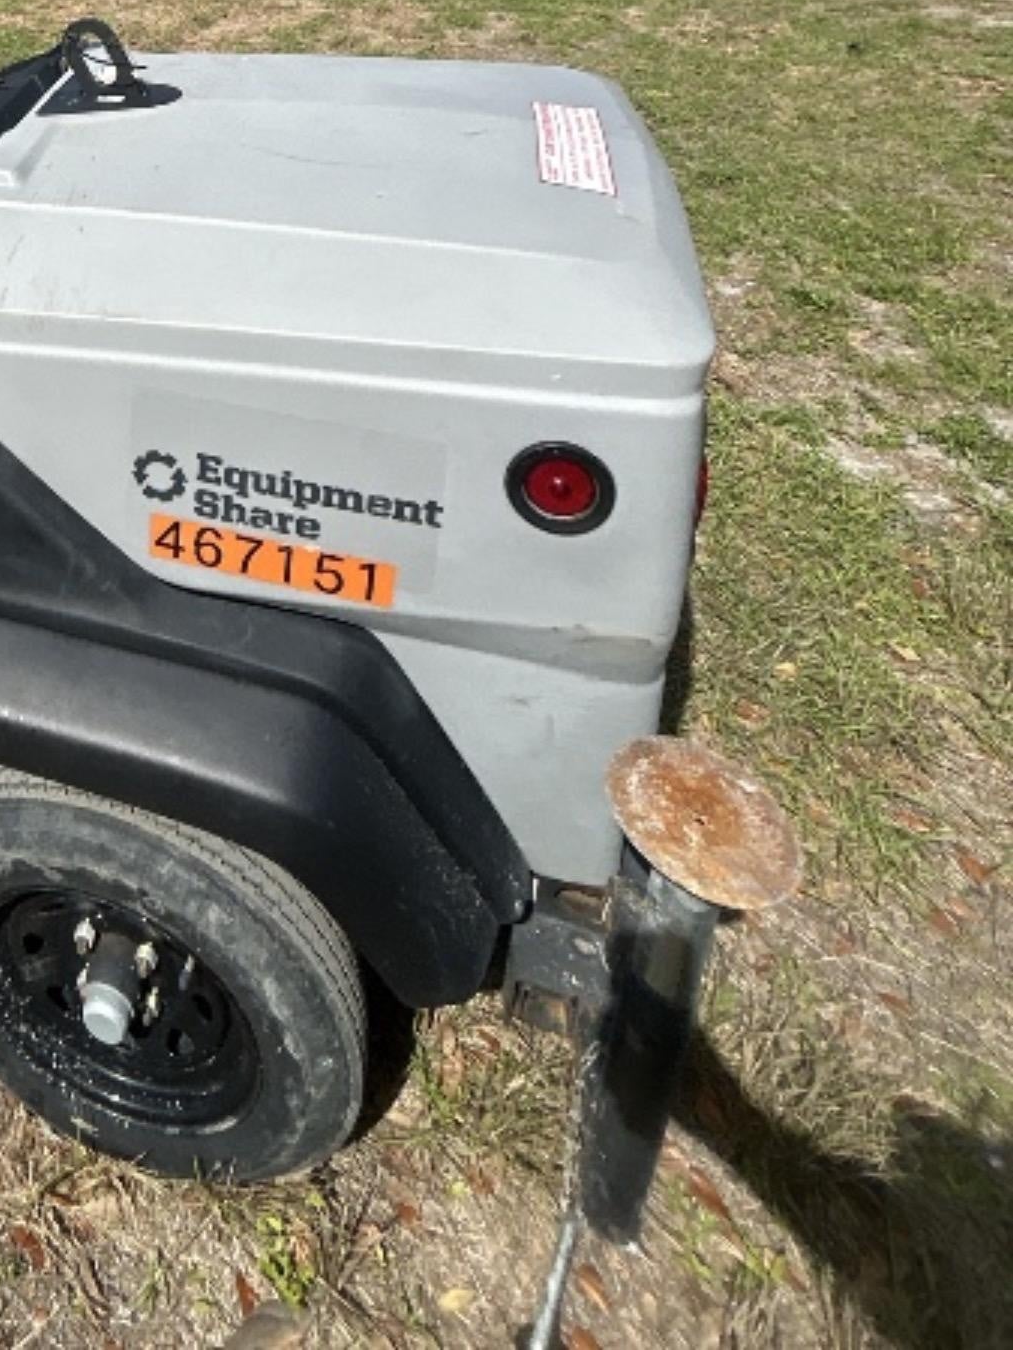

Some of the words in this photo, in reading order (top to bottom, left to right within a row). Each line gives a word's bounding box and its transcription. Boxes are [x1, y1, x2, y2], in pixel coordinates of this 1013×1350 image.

[192, 487, 322, 540] Share
[195, 451, 445, 529] Equipment
[153, 520, 378, 601] 467151
